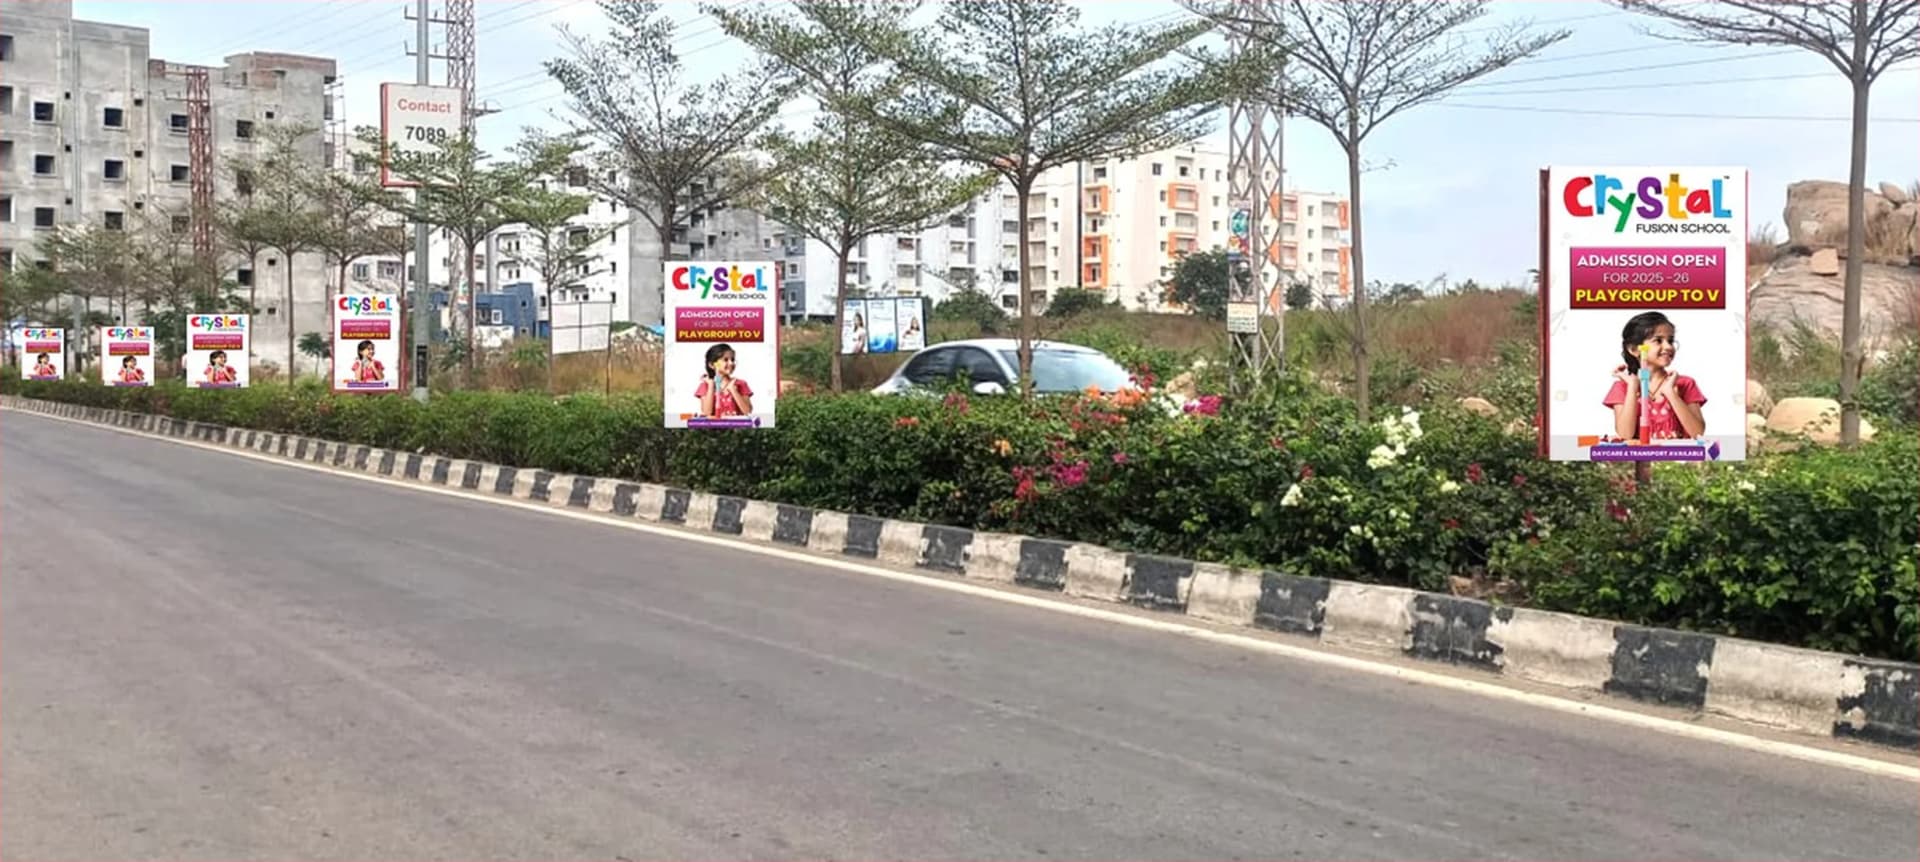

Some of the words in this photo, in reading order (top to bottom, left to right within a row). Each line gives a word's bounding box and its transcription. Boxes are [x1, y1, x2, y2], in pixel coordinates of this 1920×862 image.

[398, 98, 451, 113] Contact
[405, 125, 446, 142] 7089
[1636, 223, 1678, 233] FUSION
[1680, 223, 1731, 233] SCHOOL
[1577, 254, 1667, 267] ADMISSION
[1671, 254, 1717, 267] OPEN
[1603, 272, 1629, 284] FOR
[1575, 289, 1677, 302] PLAYGROUP
[1681, 289, 1703, 302] TO
[1707, 289, 1719, 302] V
[679, 310, 731, 318] ADMISSION
[732, 310, 760, 318] OPEN
[679, 330, 737, 338] PLAYGROUP
[738, 330, 752, 338] TO
[753, 330, 760, 338] V
